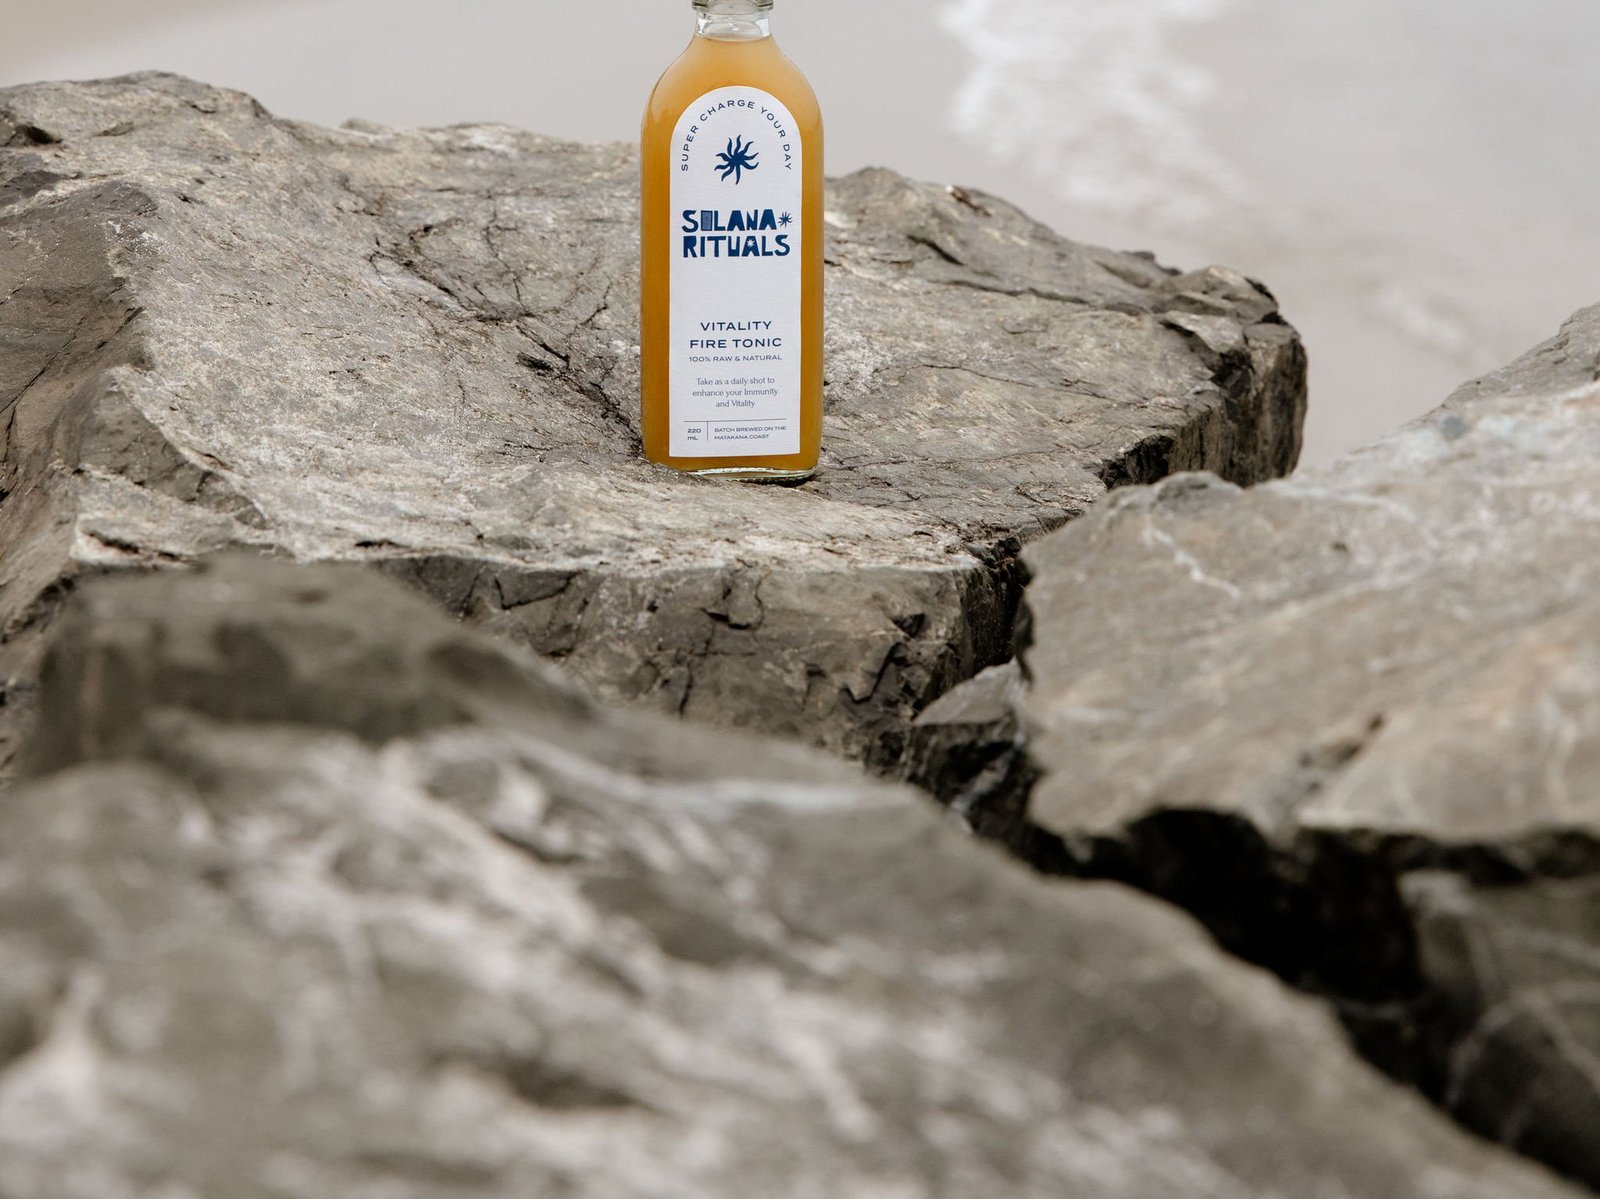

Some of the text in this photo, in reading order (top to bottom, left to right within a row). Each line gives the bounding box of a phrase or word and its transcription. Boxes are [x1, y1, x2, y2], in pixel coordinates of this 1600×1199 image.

[681, 100, 792, 171] SUPER CHARGE YOUR DAY
[683, 234, 790, 258] RITUALS
[700, 320, 772, 331] VITALITY
[690, 338, 782, 349] FIRE TONIC
[696, 378, 713, 386] Take
[730, 377, 748, 386] daily
[744, 388, 778, 397] Immunity
[731, 400, 756, 408] Vitality
